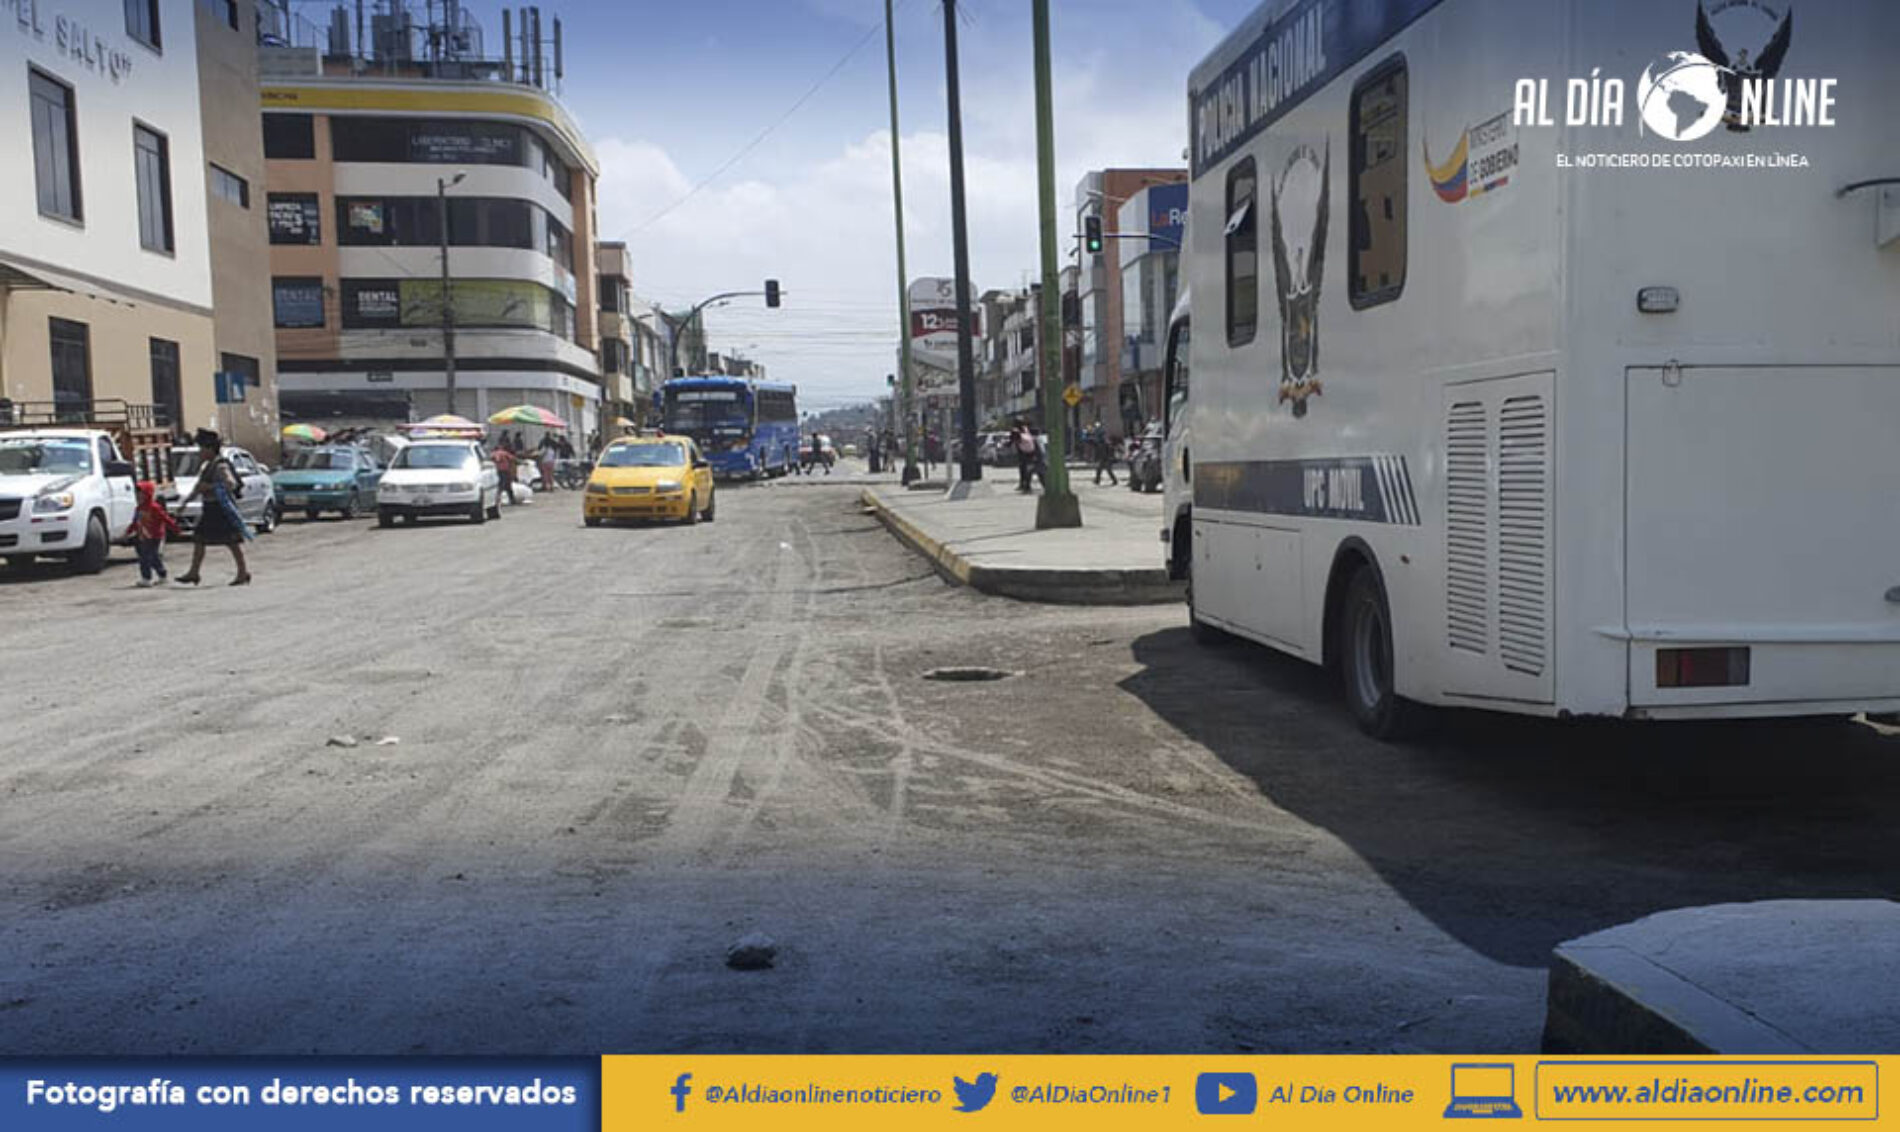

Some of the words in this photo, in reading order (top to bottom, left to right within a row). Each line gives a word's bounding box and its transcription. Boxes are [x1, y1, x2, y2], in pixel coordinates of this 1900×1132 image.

[1198, 70, 1246, 164] POLICIA
[1249, 1, 1327, 126] NACIONAL
[358, 291, 397, 302] DENTAL
